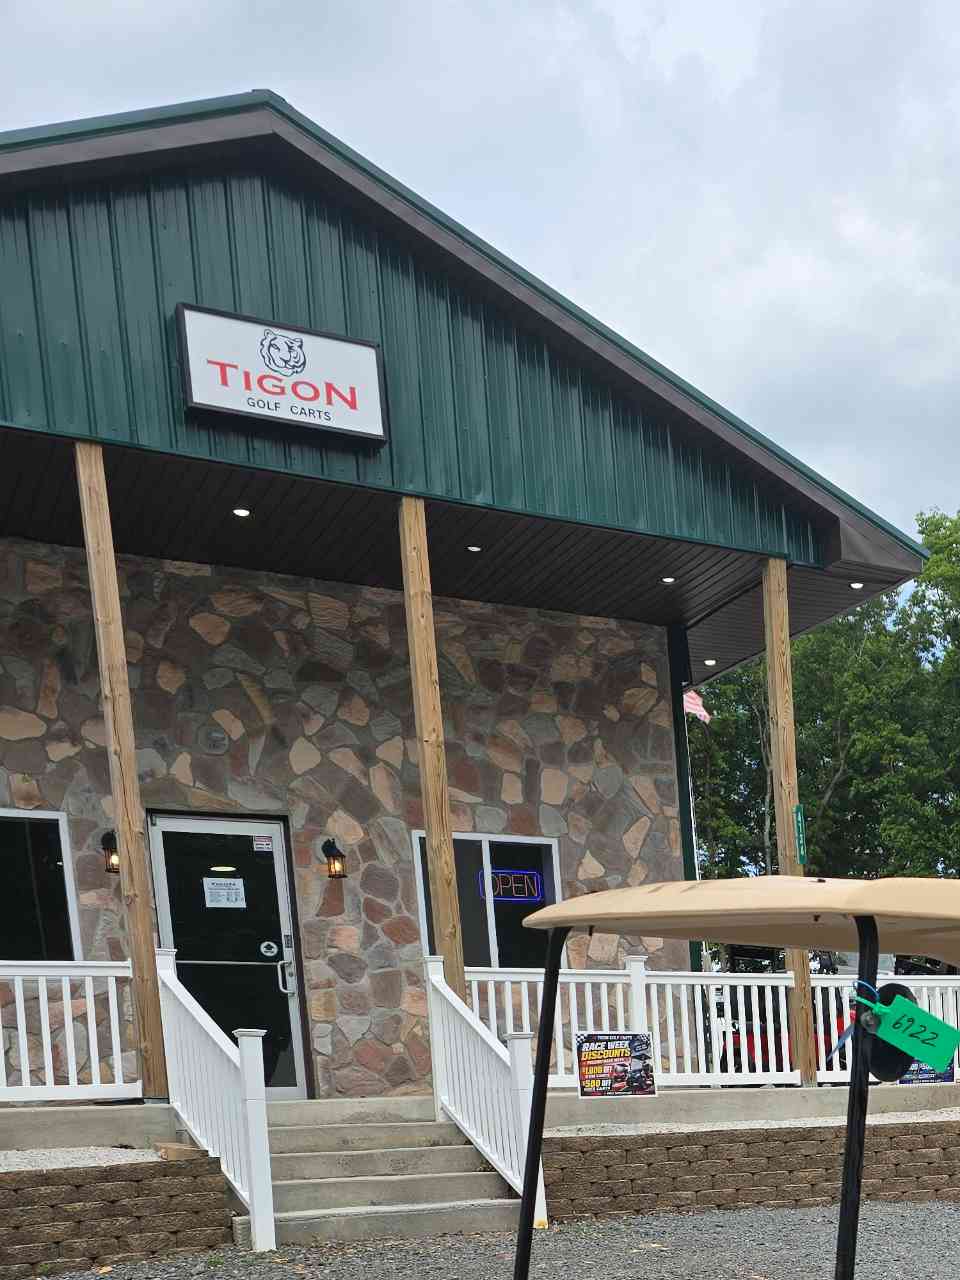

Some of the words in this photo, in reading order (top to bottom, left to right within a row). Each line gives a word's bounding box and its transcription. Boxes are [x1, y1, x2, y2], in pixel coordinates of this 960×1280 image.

[207, 359, 358, 411] TIGON
[246, 396, 281, 412] GOLF
[289, 404, 332, 422] CARTS
[490, 873, 538, 897] OPEN
[581, 1049, 631, 1060] DISCOUNTS
[582, 1042, 606, 1052] RACE
[607, 1040, 630, 1050] WEEK
